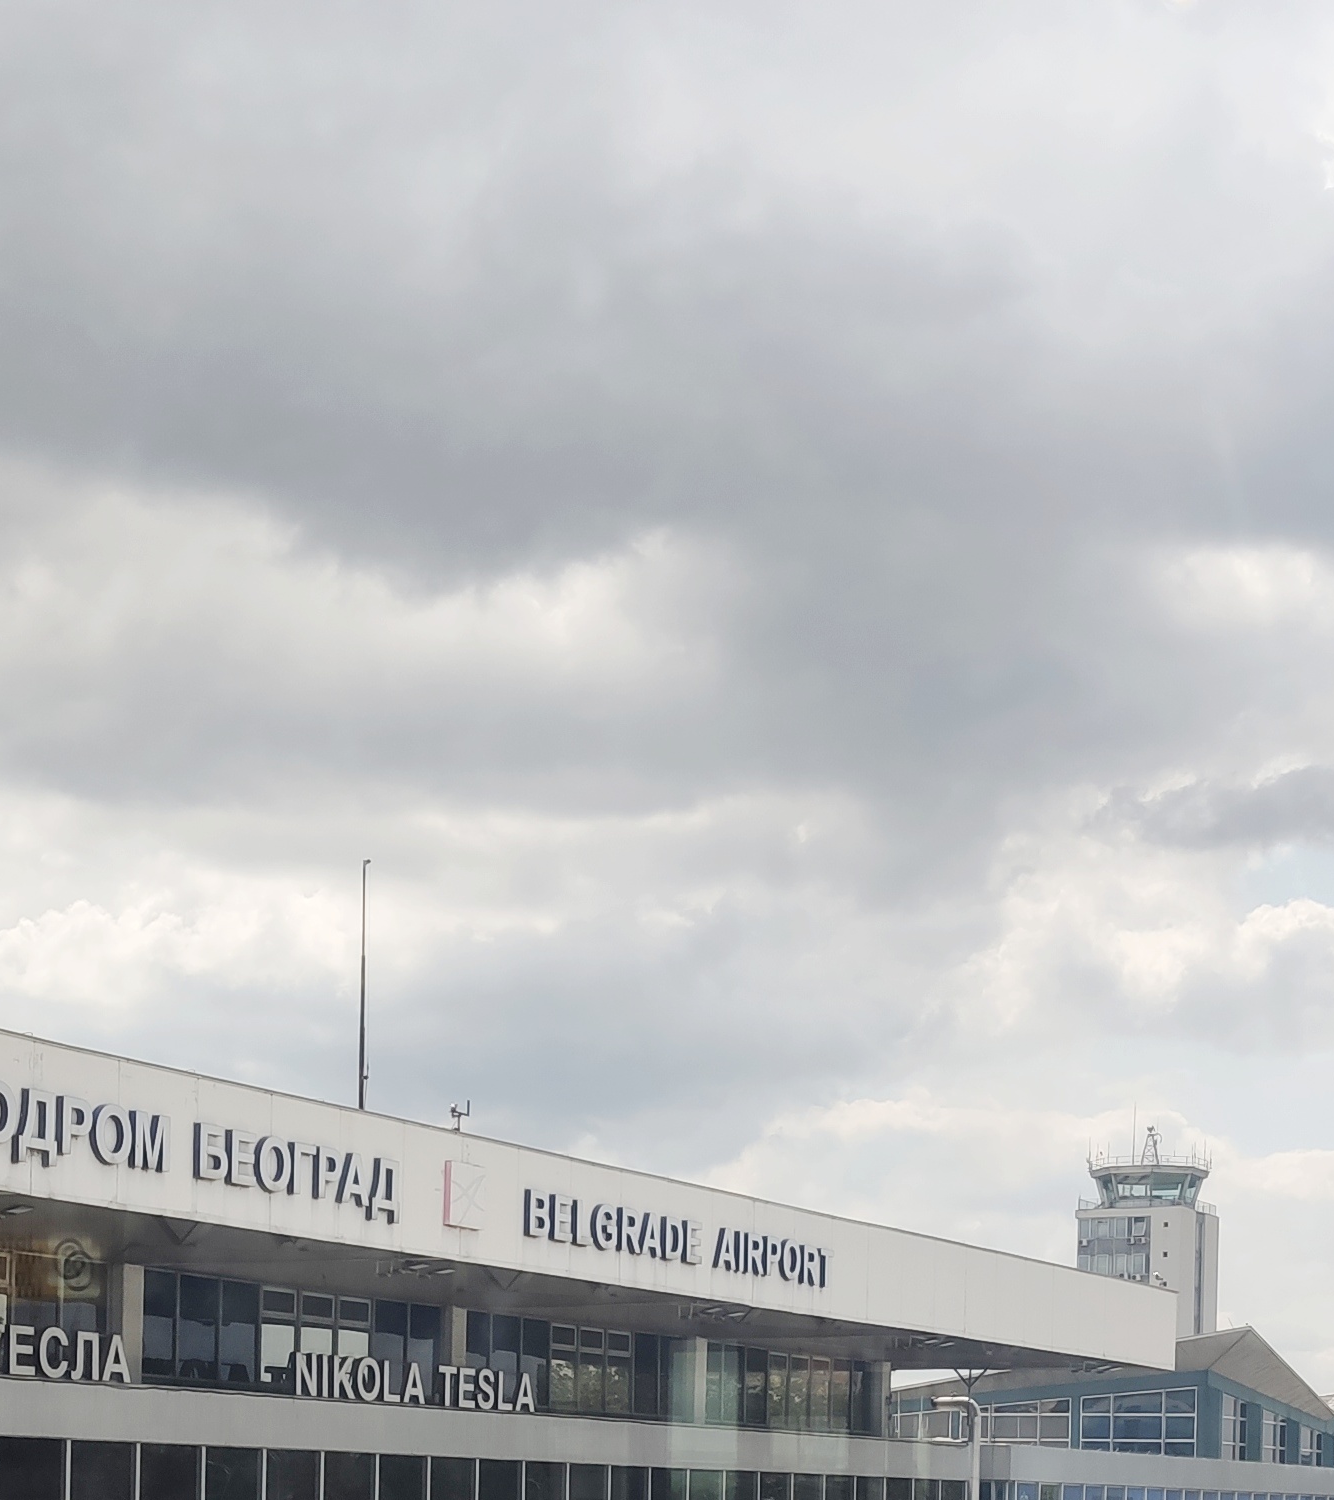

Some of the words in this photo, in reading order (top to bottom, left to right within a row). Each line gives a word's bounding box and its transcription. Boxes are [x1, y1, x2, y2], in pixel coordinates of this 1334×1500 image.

[193, 1122, 401, 1224] БЕОГРАД
[524, 1187, 703, 1266] BELGRADE
[713, 1226, 835, 1289] AIRPORT
[294, 1351, 427, 1406] NIKOLA
[439, 1364, 536, 1413] TESLA
